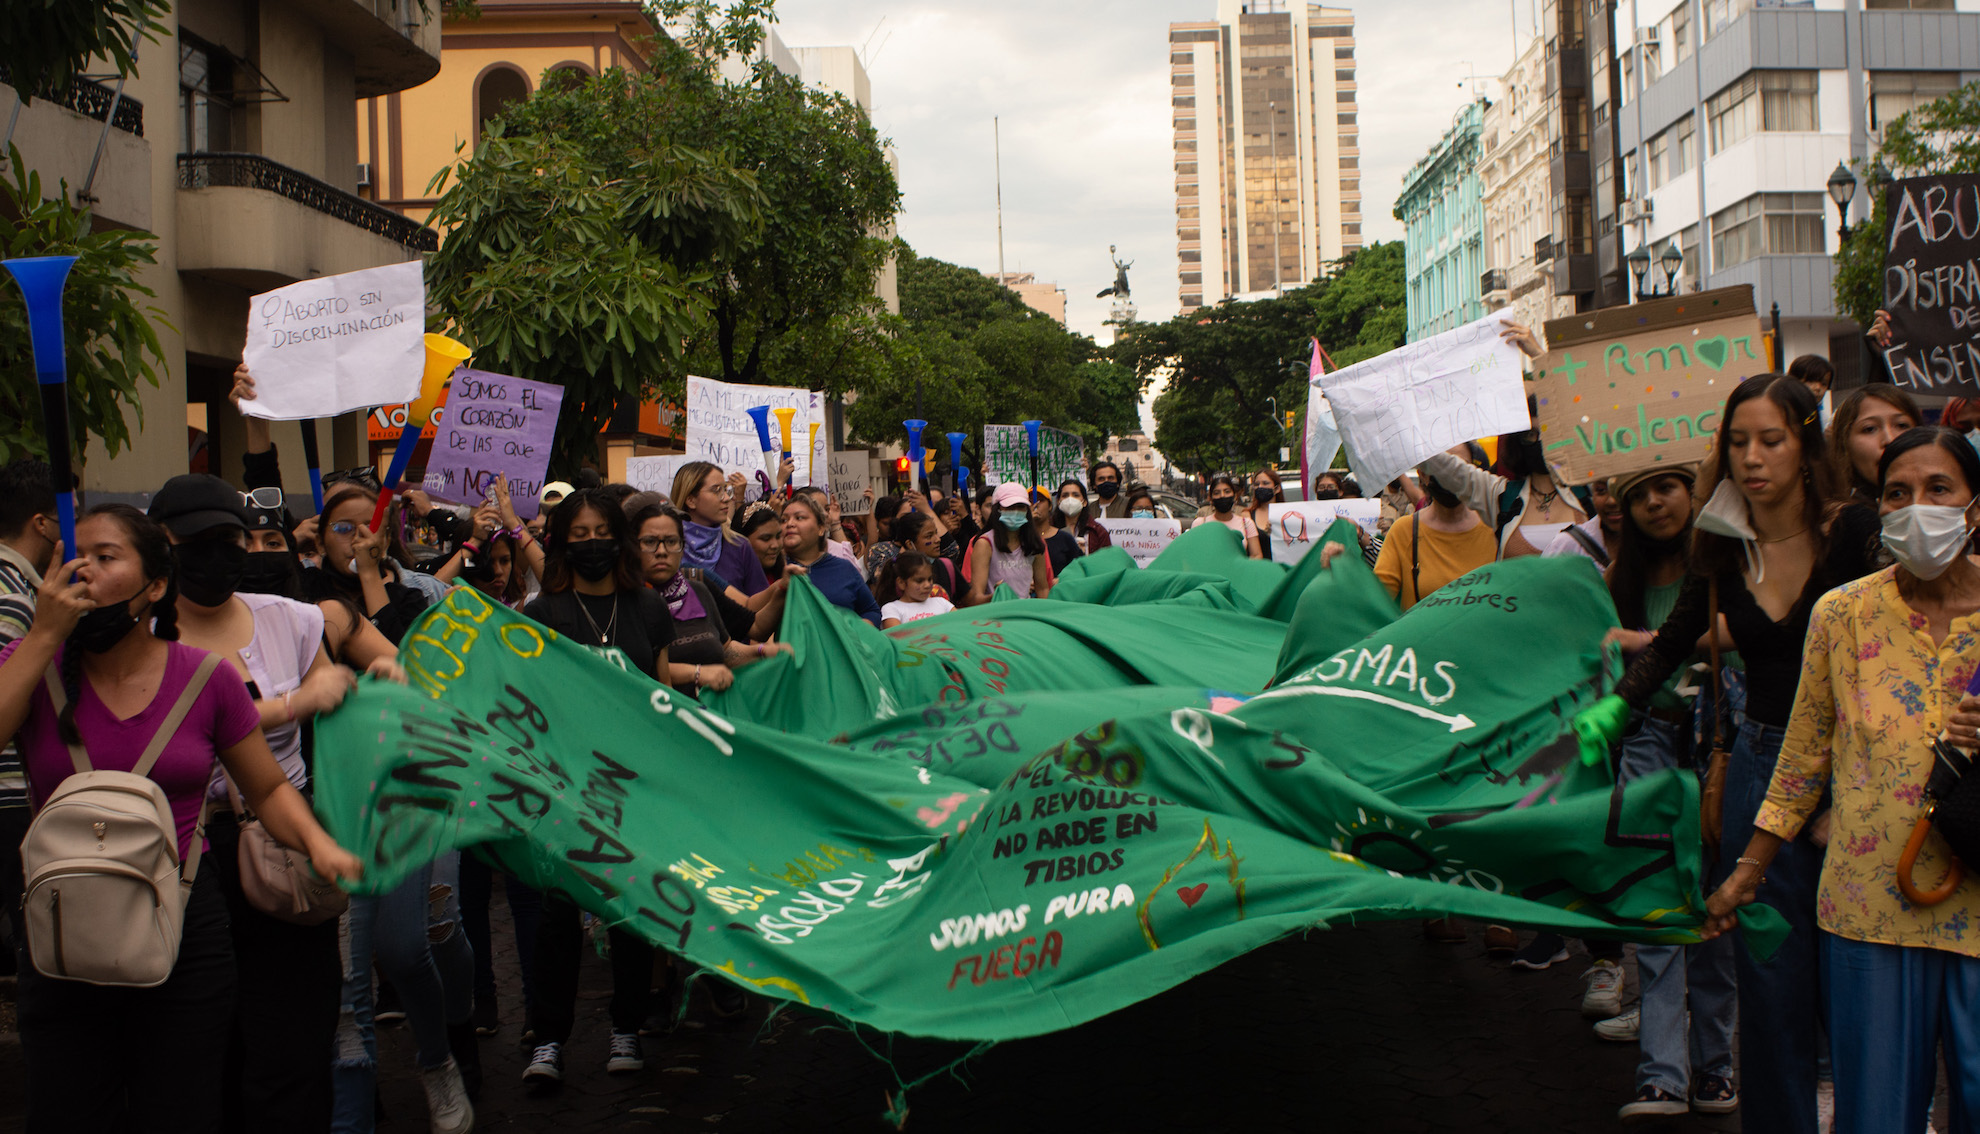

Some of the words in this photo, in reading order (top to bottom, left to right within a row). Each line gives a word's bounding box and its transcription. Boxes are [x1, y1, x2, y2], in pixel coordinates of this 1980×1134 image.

[1888, 184, 1980, 252] ABU
[1885, 258, 1980, 311] DiSFRA
[283, 297, 349, 324] ABORTO
[360, 291, 382, 306] SIN
[272, 309, 404, 348] DISCRIMINACIÓN
[459, 377, 507, 400] SOMOS
[521, 389, 543, 411] EL
[461, 407, 526, 430] CORAZÓN
[1575, 400, 1726, 455] Violenci
[709, 442, 730, 465] NO
[509, 478, 542, 499] ATEN
[1037, 817, 1108, 851] ARDE
[1116, 811, 1158, 839] EN
[1024, 848, 1125, 887] TIBIOS
[930, 903, 1031, 951] SOMOS
[1044, 884, 1136, 924] PURA
[947, 930, 1064, 992] FUEGA
